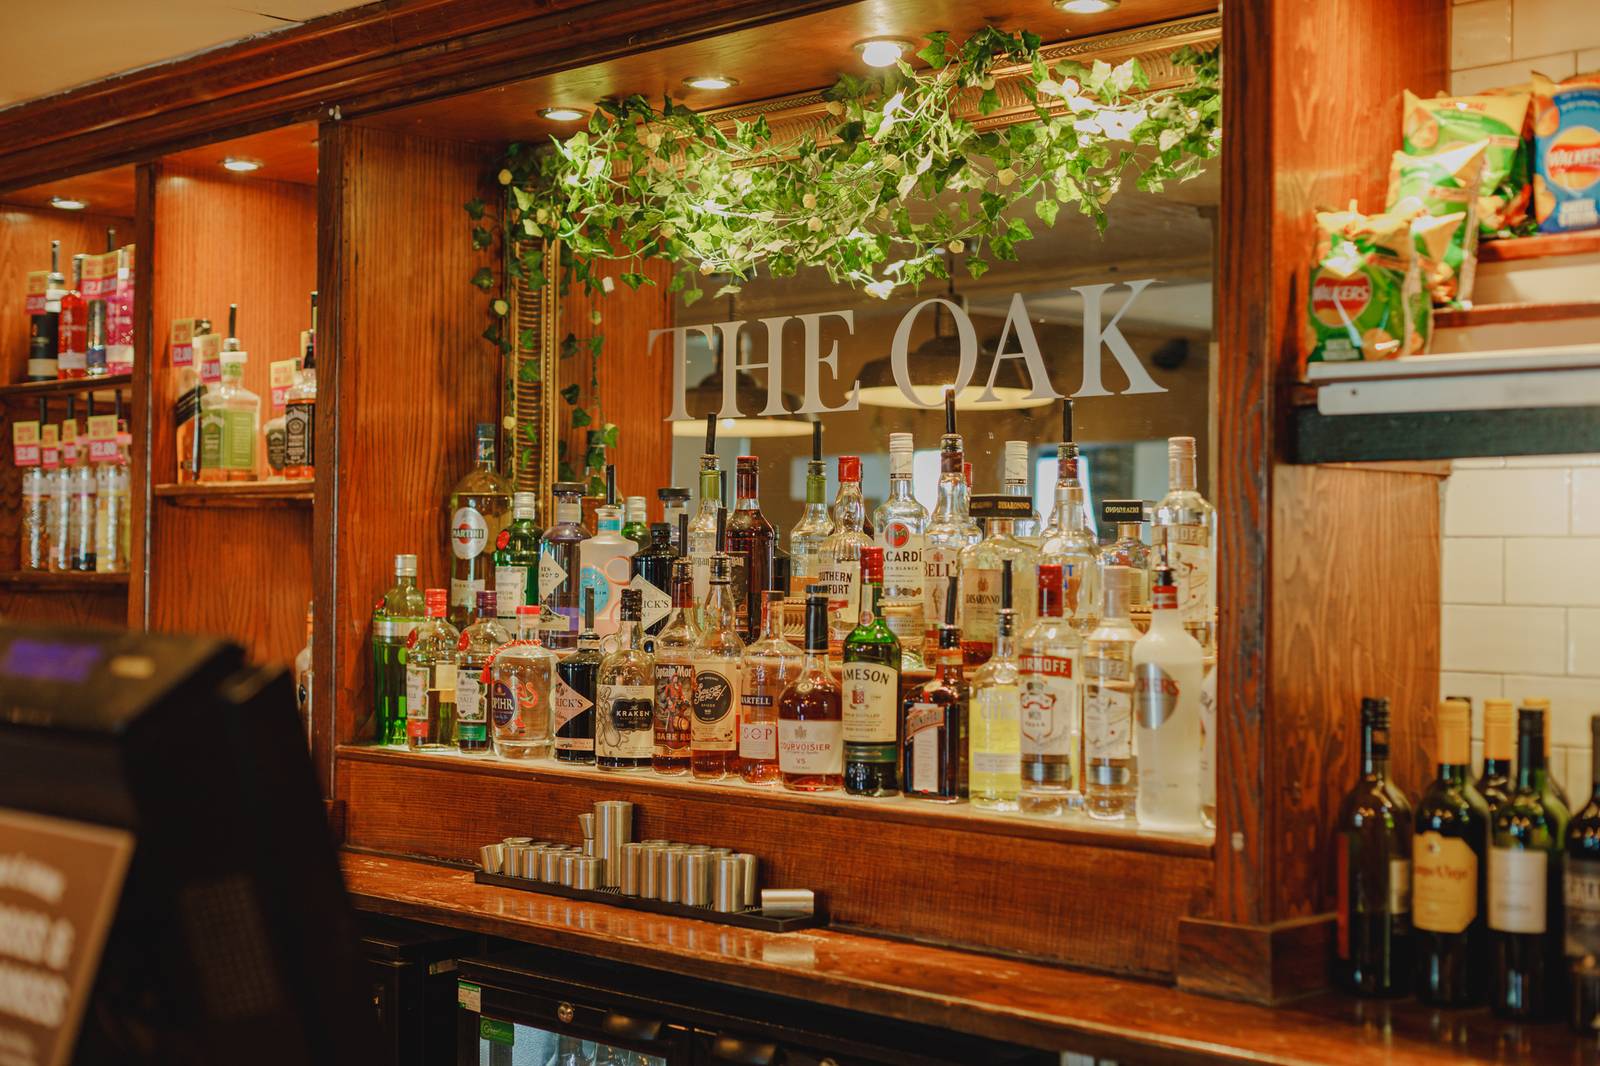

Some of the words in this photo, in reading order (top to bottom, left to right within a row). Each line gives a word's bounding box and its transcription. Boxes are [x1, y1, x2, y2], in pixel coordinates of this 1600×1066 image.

[1313, 285, 1369, 301] WALKERS
[647, 309, 860, 422] THE
[890, 277, 1169, 408] OAK
[924, 561, 956, 578] BELL'
[818, 571, 853, 583] OUTHERN
[641, 598, 669, 609] ICK'S
[675, 664, 691, 678] Mor
[556, 698, 583, 708] ICK'S
[680, 732, 691, 741] RU
